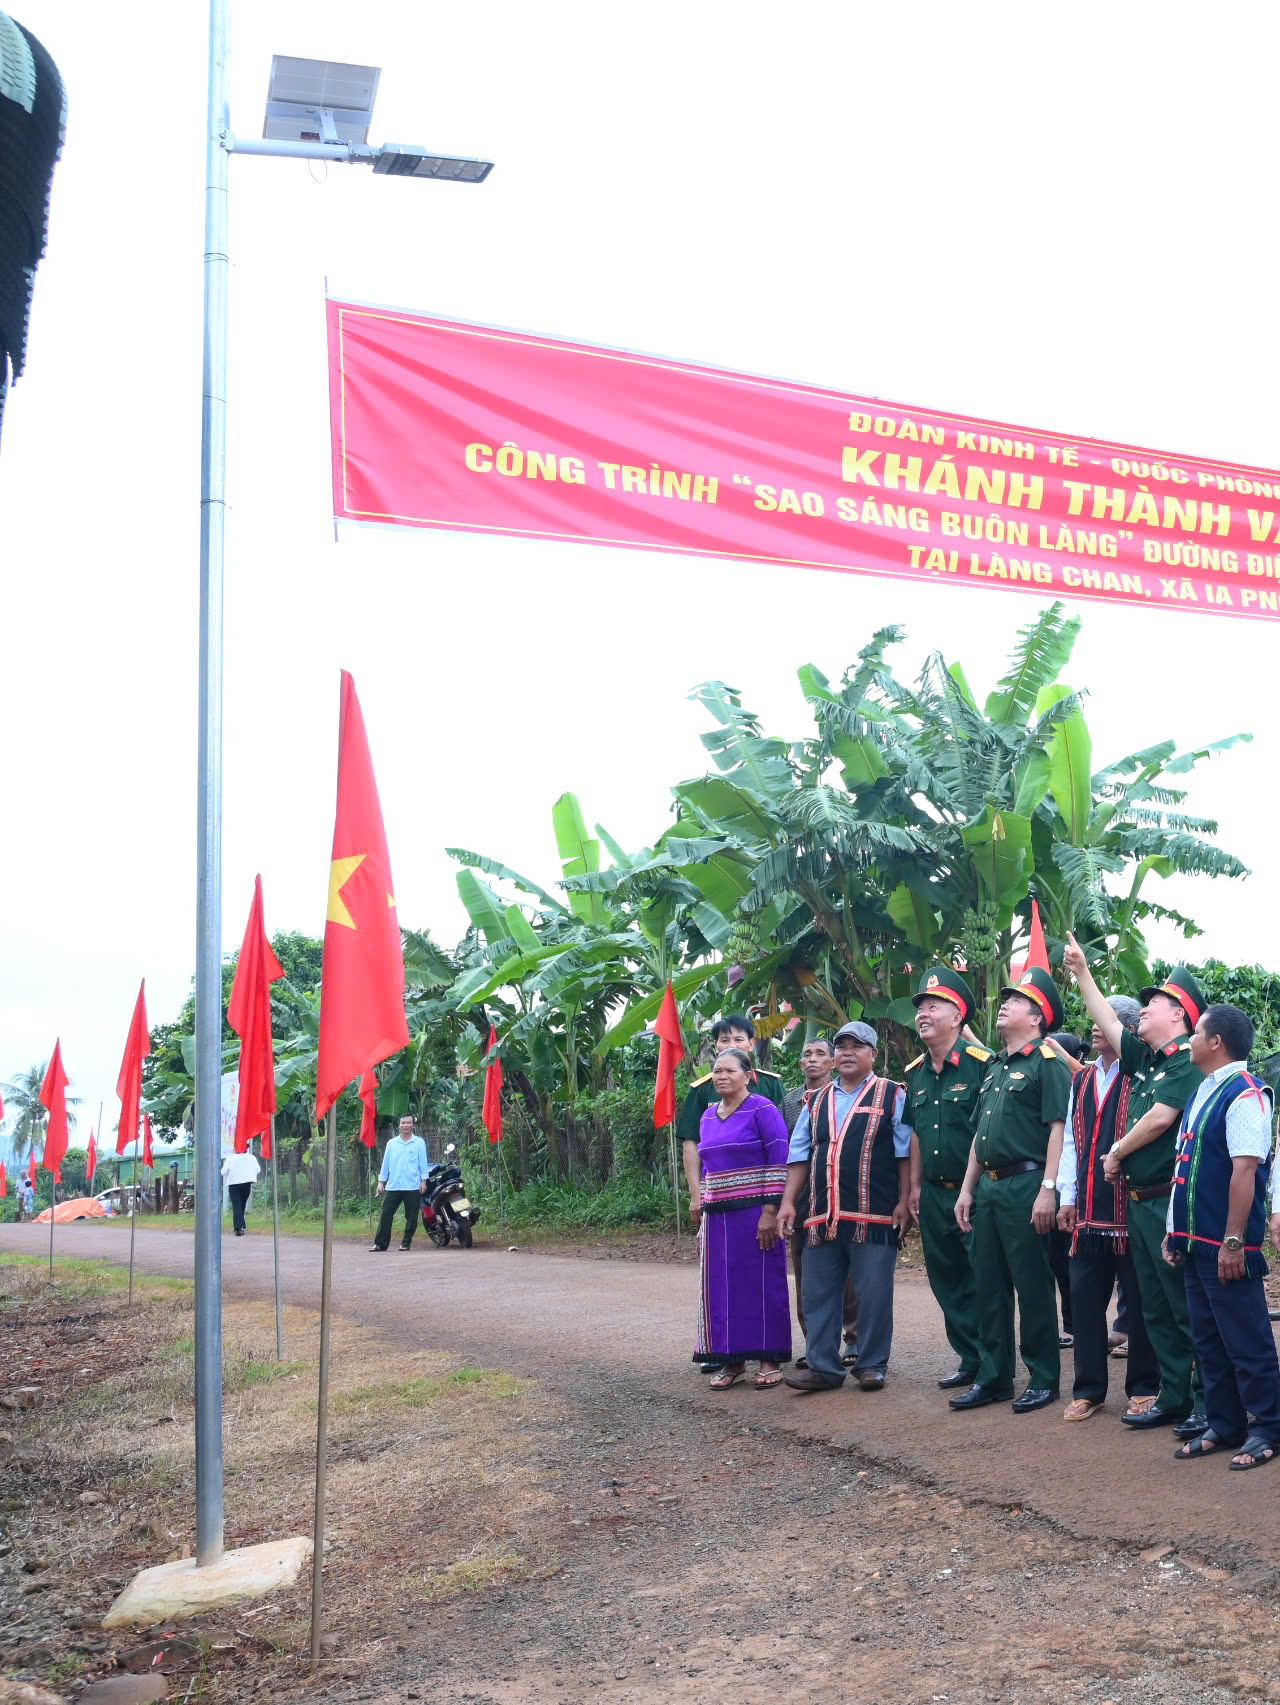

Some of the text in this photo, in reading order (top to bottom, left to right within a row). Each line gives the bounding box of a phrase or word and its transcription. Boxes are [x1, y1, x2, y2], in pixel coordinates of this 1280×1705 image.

[848, 411, 946, 446] ĐOÀN
[956, 431, 1035, 461] KINH
[1045, 445, 1080, 468] TẾ
[1111, 456, 1189, 485] QUỐC
[465, 440, 586, 485] CÔNG
[597, 460, 719, 505] TRÌNH
[732, 474, 825, 518] “SAO
[836, 494, 930, 533] SÁNG
[940, 508, 1030, 547] BUÔN
[1039, 519, 1134, 559] LÀNG”
[1143, 538, 1240, 575] ĐƯỜNG
[840, 445, 1045, 511] KHÁNH
[1063, 480, 1232, 538] THÀNH
[907, 545, 960, 576] TẠI
[969, 549, 1054, 585] LÀNG
[1062, 566, 1153, 600] CHAN,
[1160, 574, 1198, 602] XÃ
[1205, 583, 1234, 606] IA
